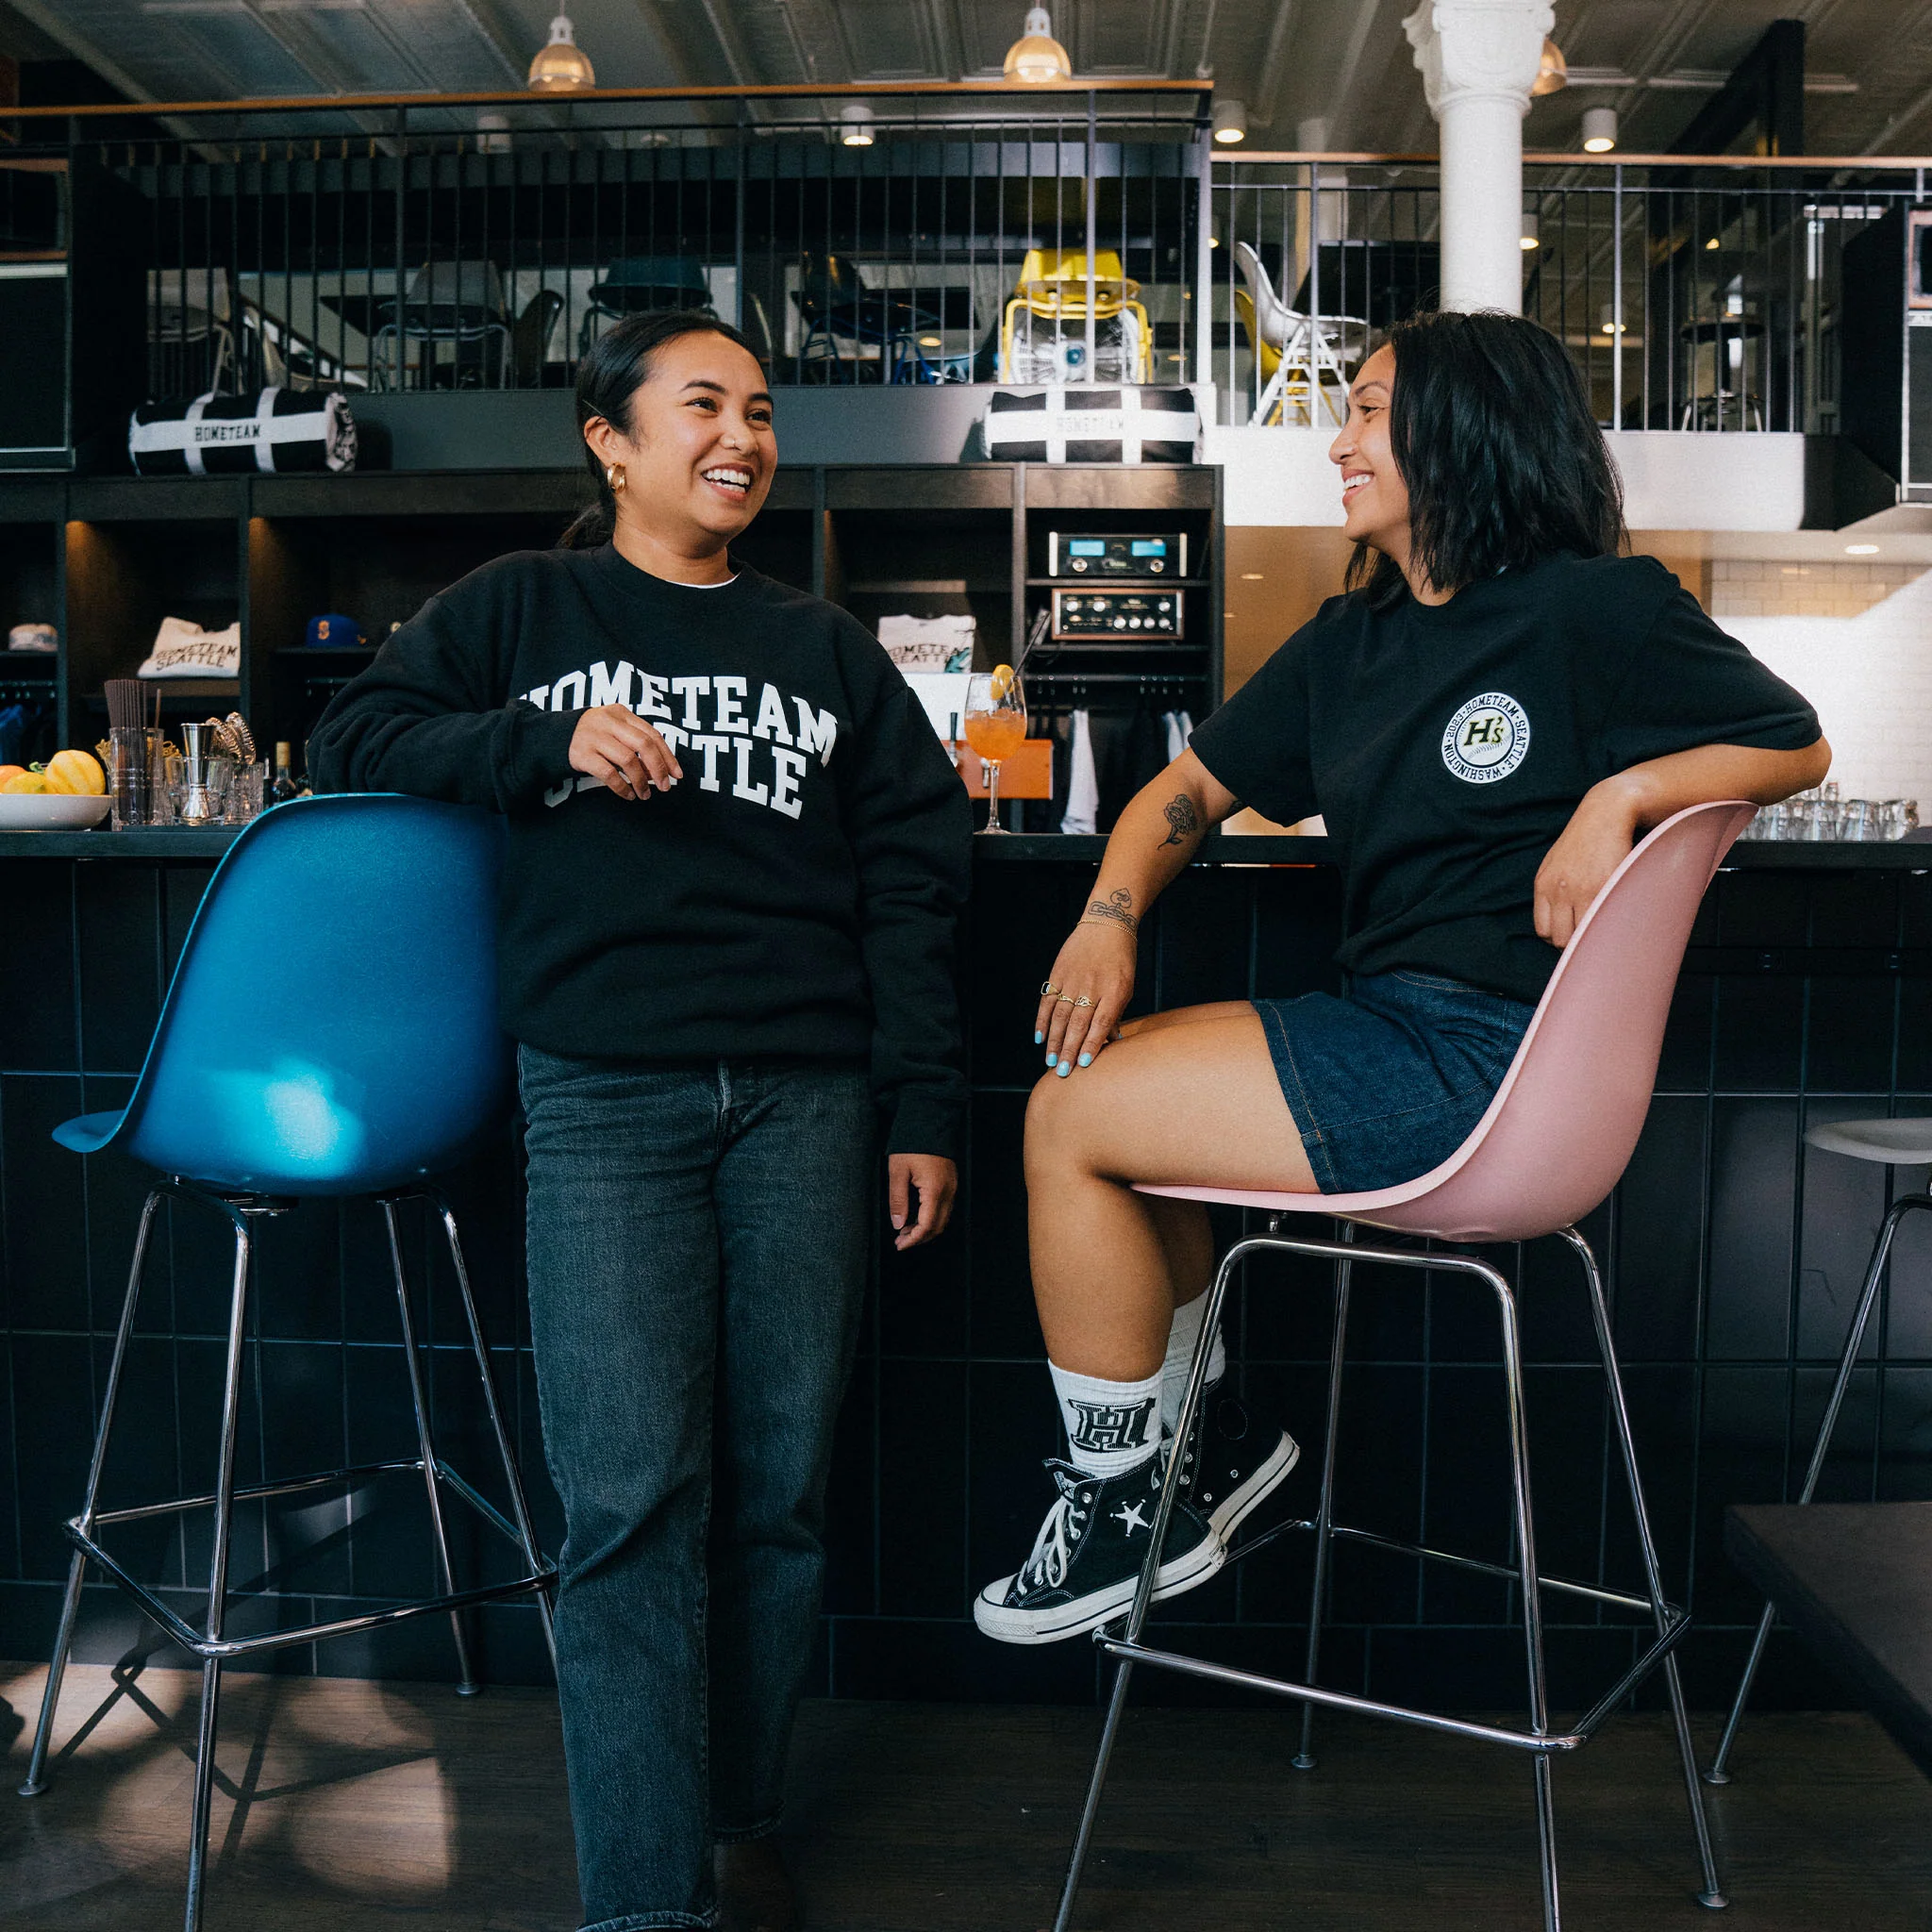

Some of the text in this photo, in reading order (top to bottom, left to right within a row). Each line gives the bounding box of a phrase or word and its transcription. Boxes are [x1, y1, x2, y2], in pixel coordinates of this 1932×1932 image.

[194, 424, 261, 442] HOMETEAM
[156, 653, 227, 671] SEATTLE
[1443, 694, 1527, 781] HOMETEAM SEATTLE WASHINGTON 2023
[1463, 716, 1505, 746] H's
